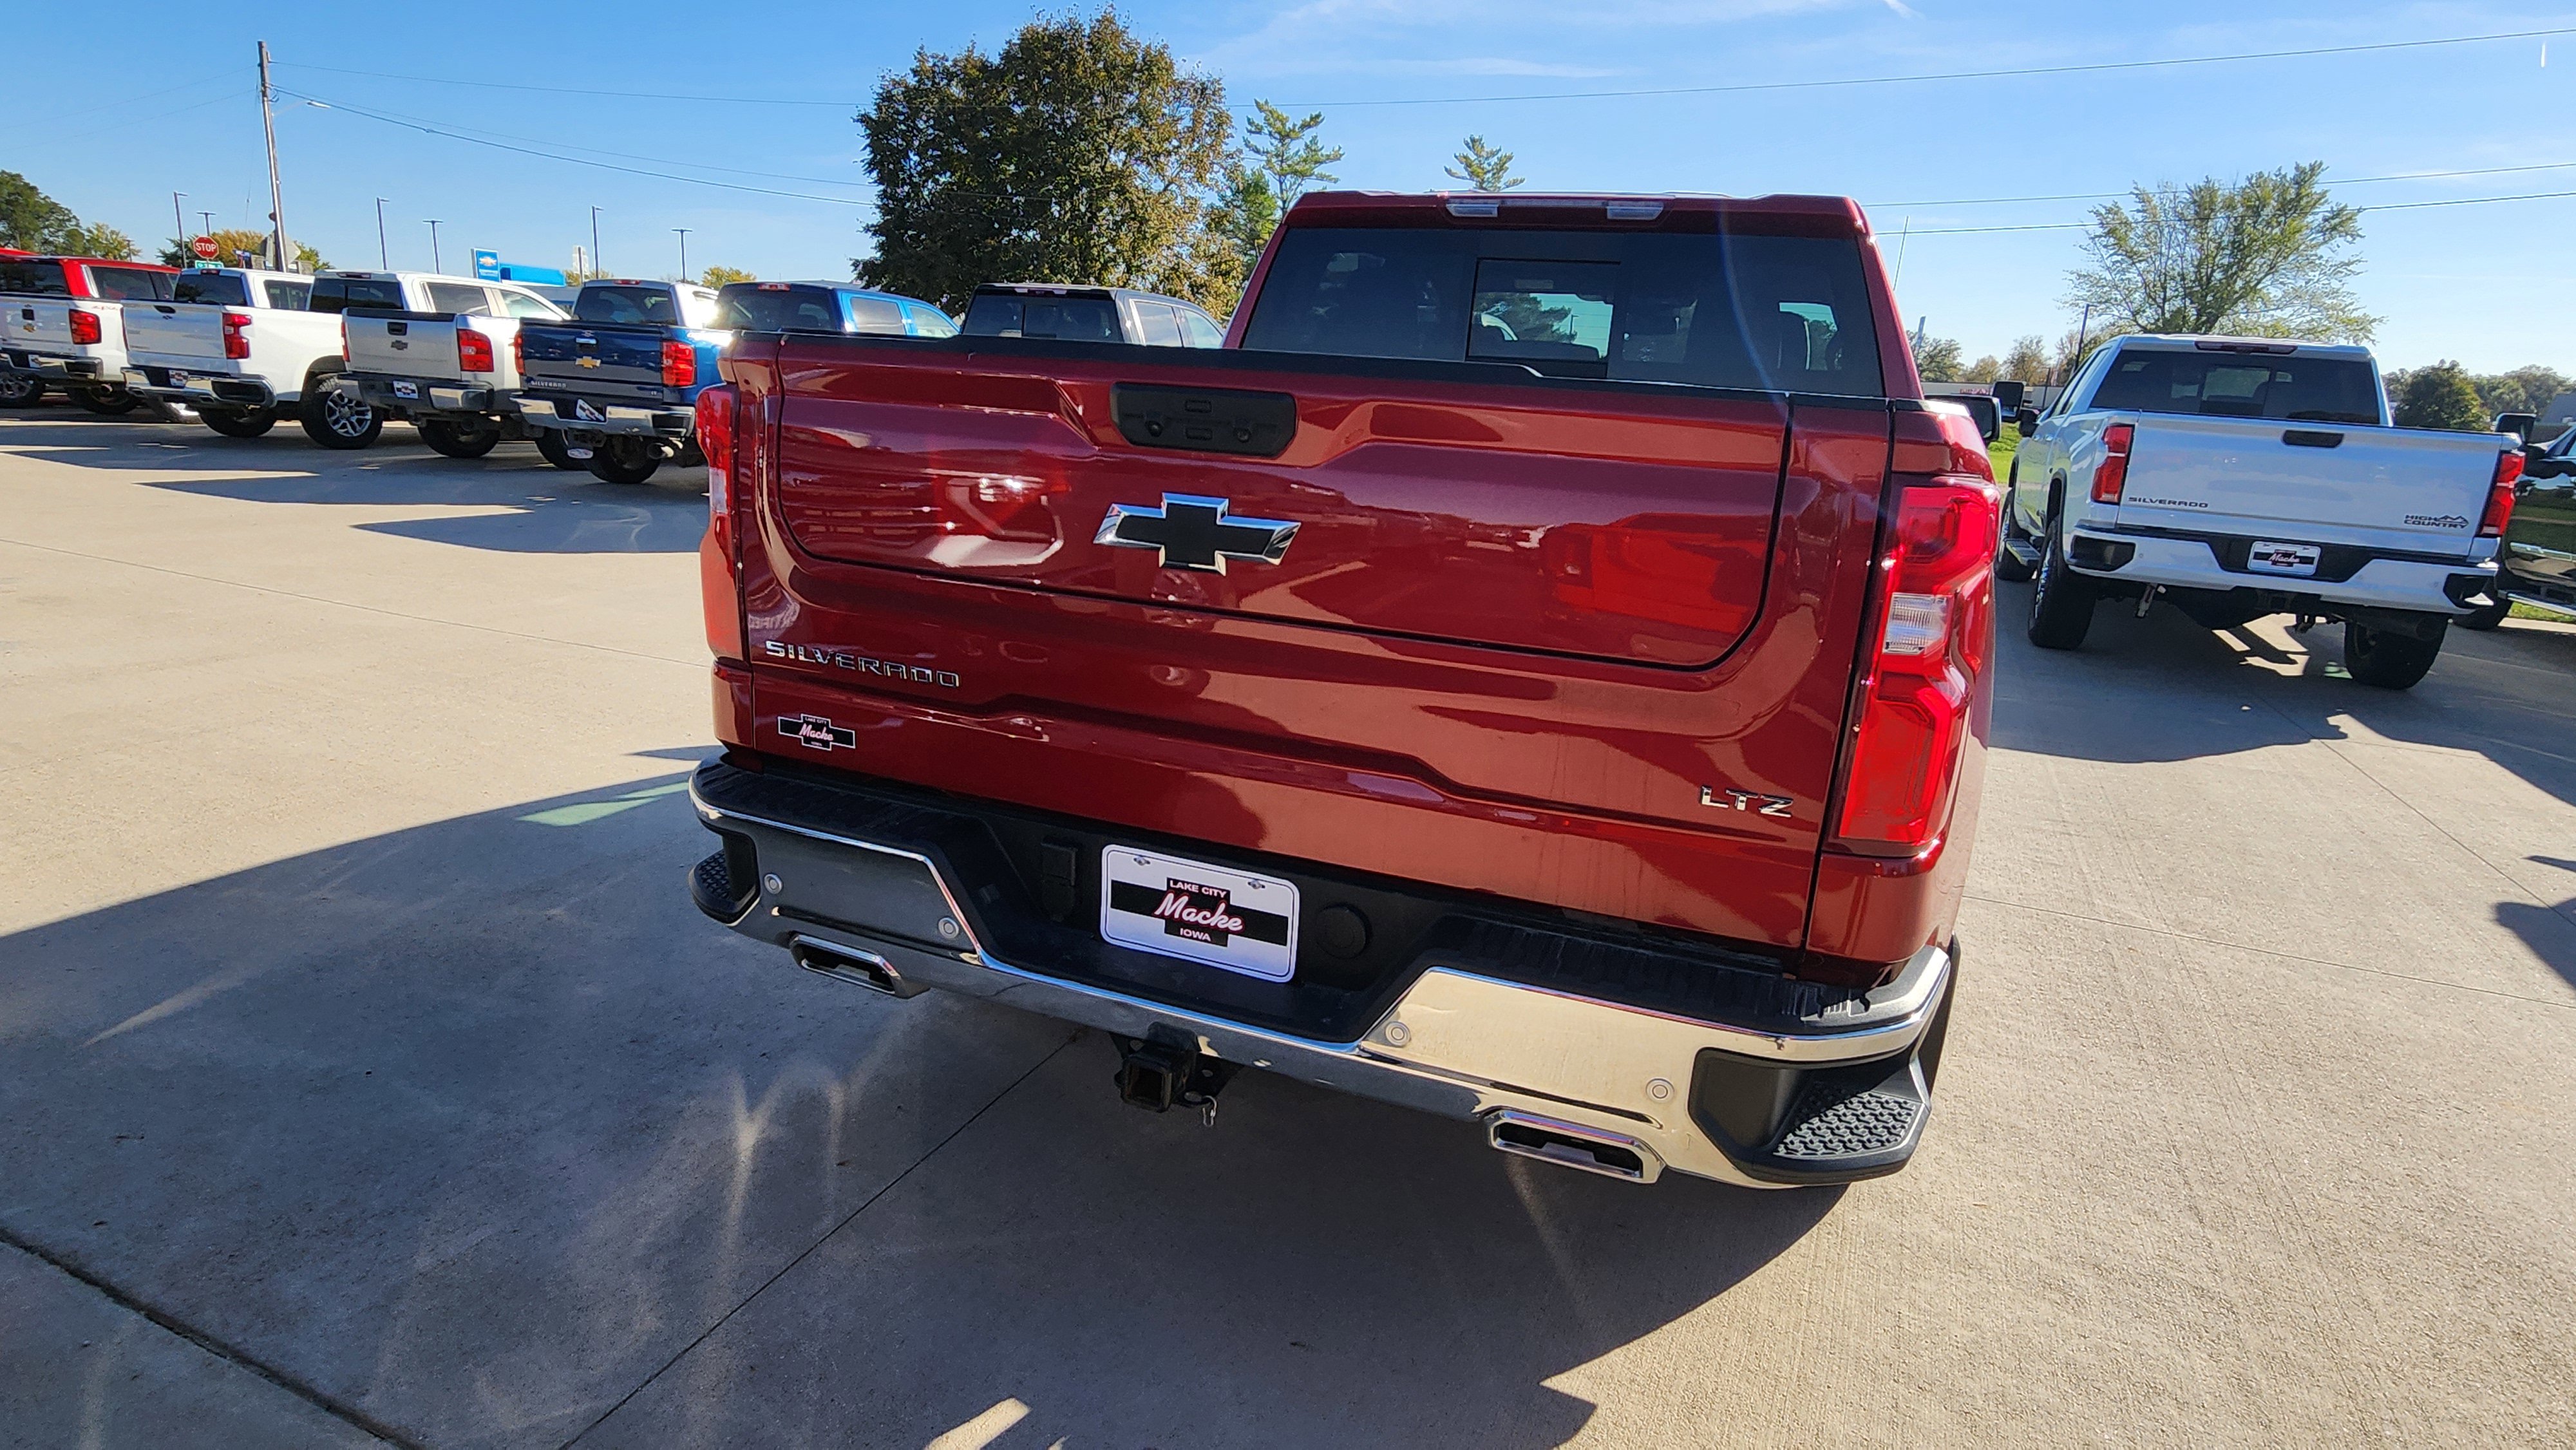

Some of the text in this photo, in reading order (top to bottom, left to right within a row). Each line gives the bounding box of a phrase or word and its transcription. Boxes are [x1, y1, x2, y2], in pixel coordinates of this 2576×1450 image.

[195, 242, 217, 252] STOP
[2128, 496, 2209, 508] SILVERADO
[2403, 519, 2468, 529] COUNTRY
[765, 640, 960, 688] SILVERADO
[799, 722, 833, 740] Macke
[1701, 786, 1794, 818] LTZ
[1170, 880, 1227, 898] LAKE CITY
[1153, 892, 1243, 931] Macke
[1180, 928, 1211, 941] IOWA
